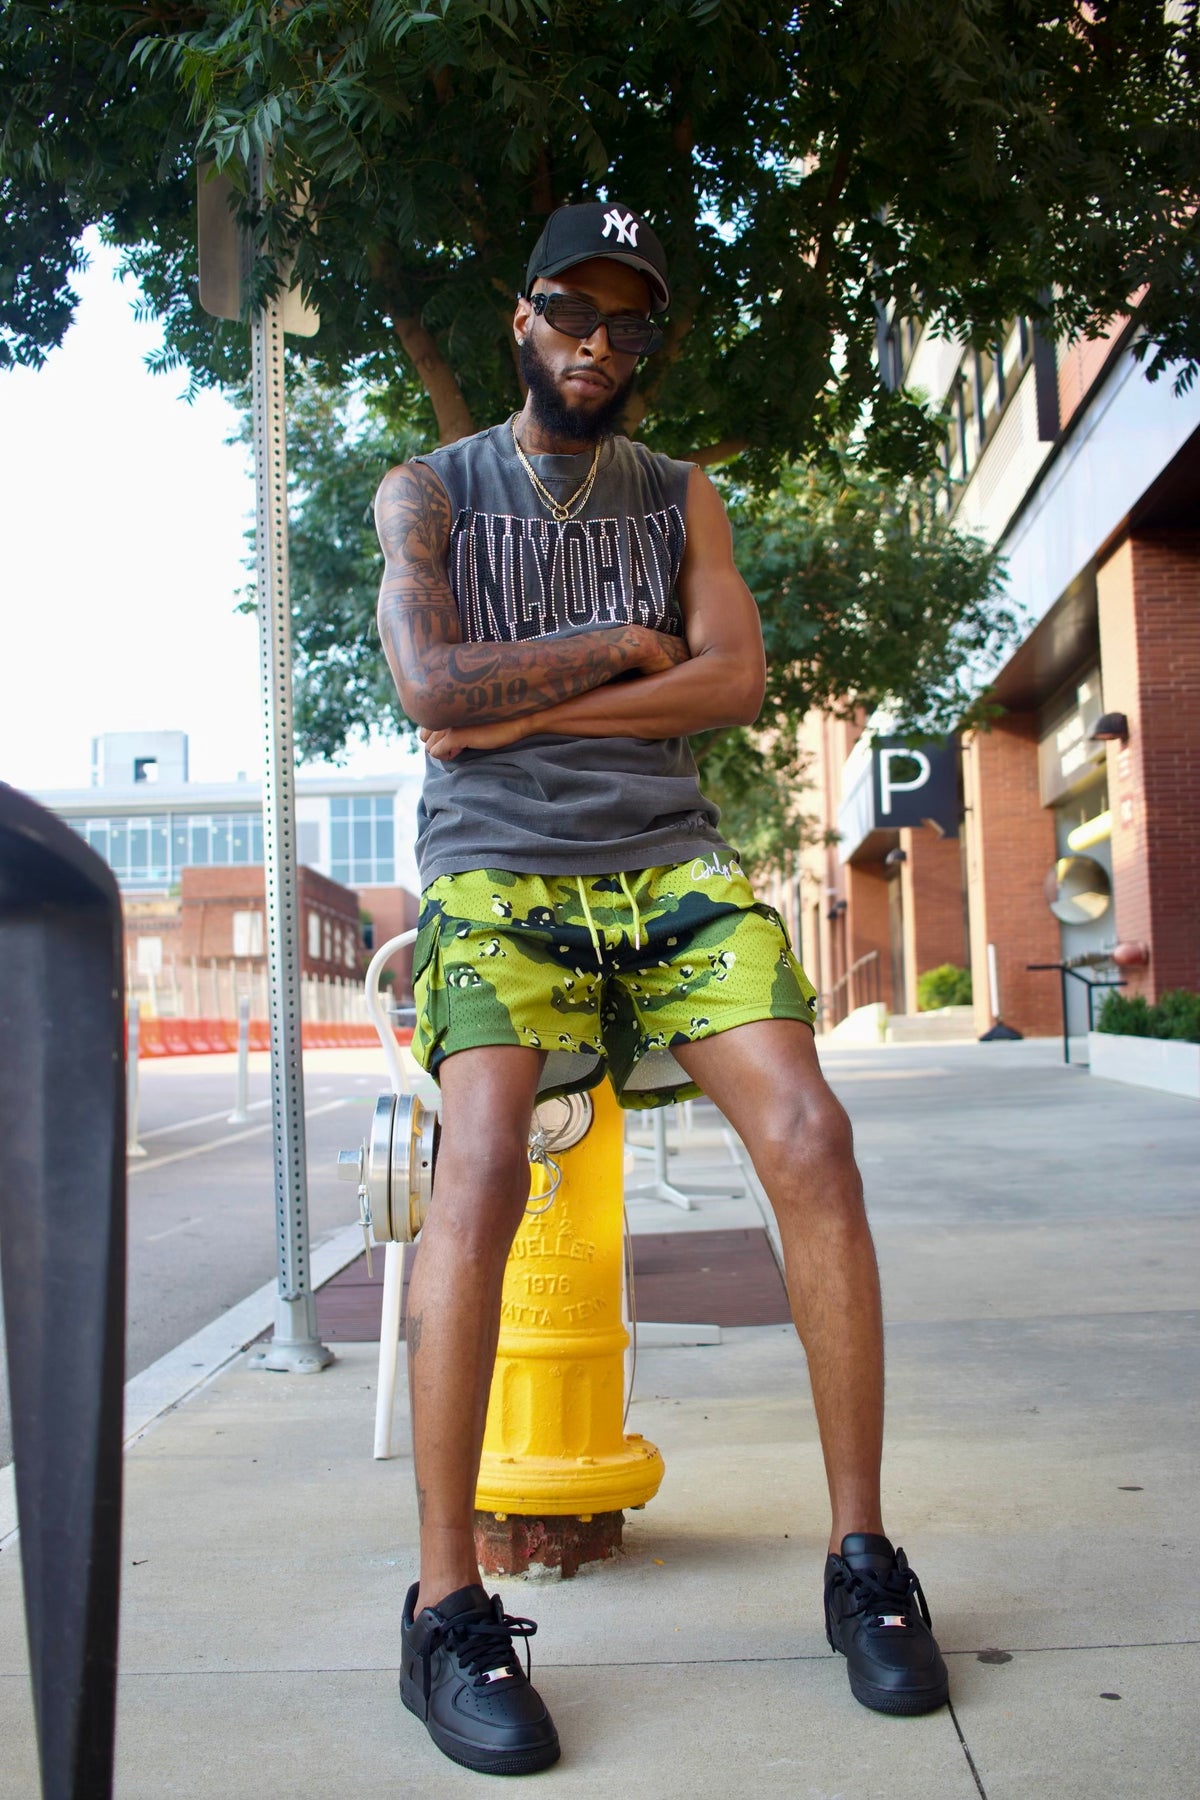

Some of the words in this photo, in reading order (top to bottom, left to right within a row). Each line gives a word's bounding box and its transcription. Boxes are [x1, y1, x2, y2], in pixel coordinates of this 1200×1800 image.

[602, 209, 639, 248] NY
[879, 747, 931, 815] P
[524, 1273, 571, 1295] 1976
